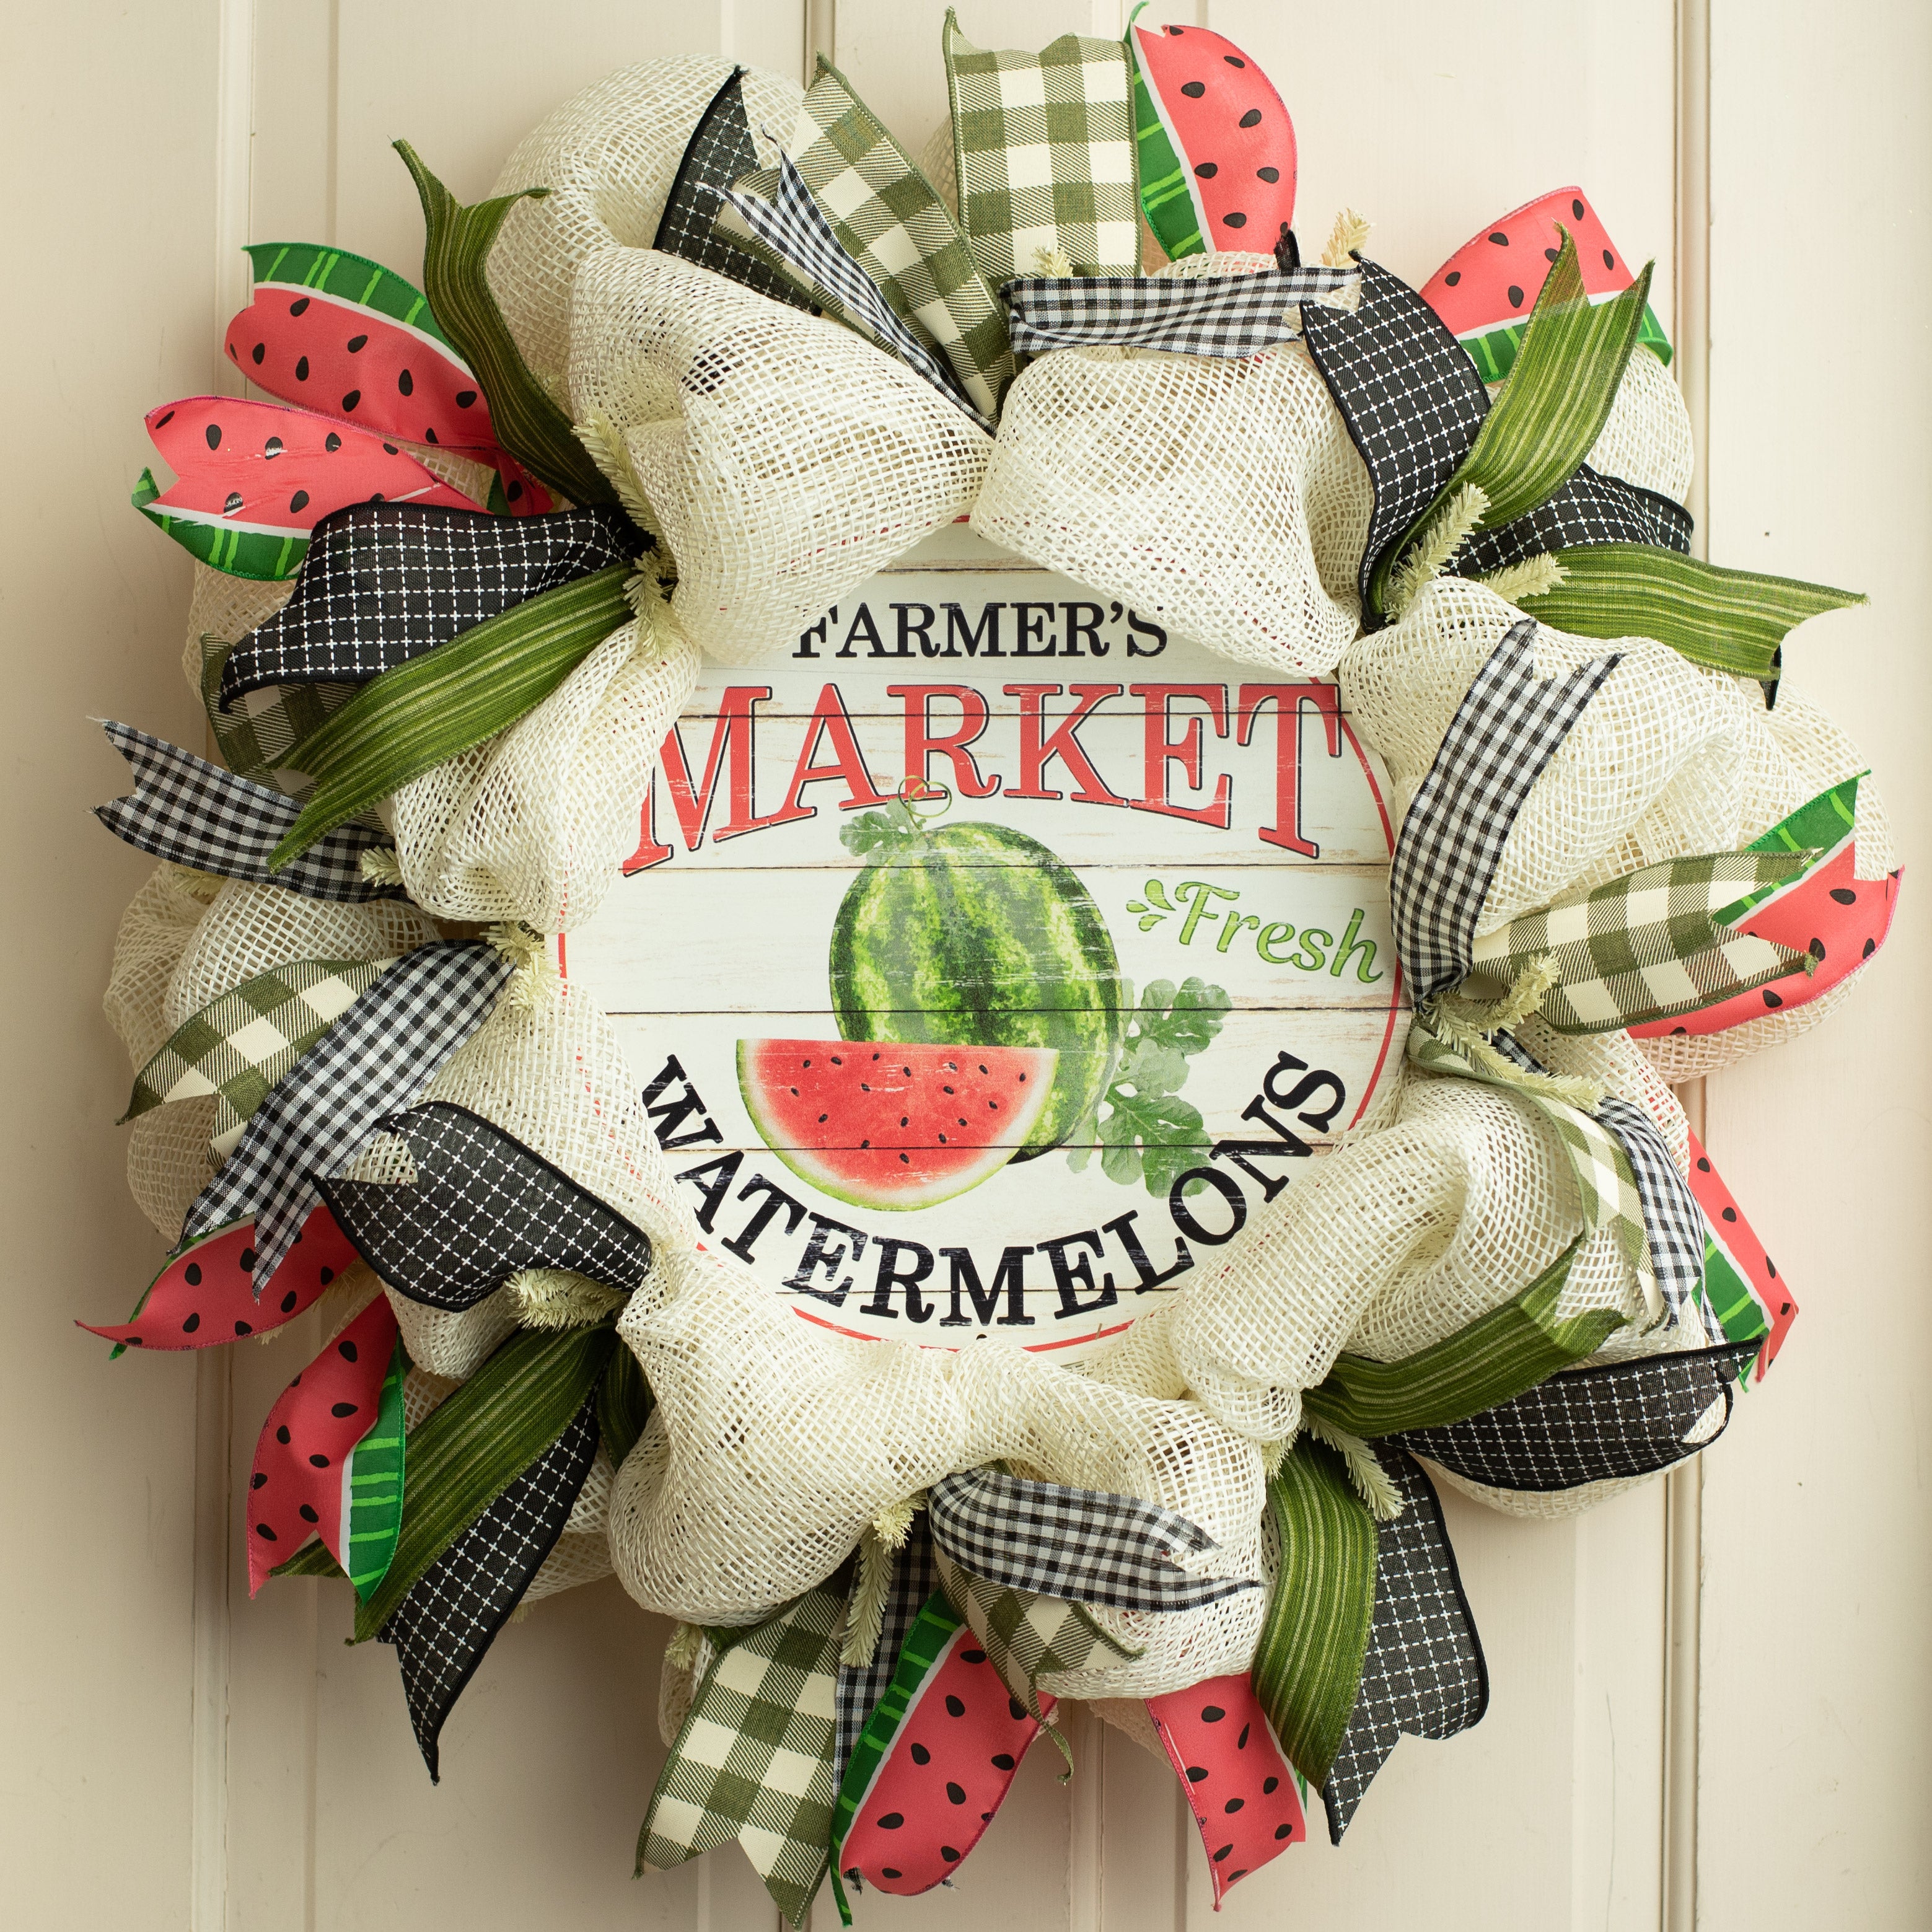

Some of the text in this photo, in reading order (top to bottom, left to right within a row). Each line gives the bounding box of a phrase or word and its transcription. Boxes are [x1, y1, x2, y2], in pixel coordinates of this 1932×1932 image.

[622, 683, 1342, 877] MARKET
[1174, 881, 1383, 983] Fresh
[642, 1050, 1346, 1327] WATERMELONS
